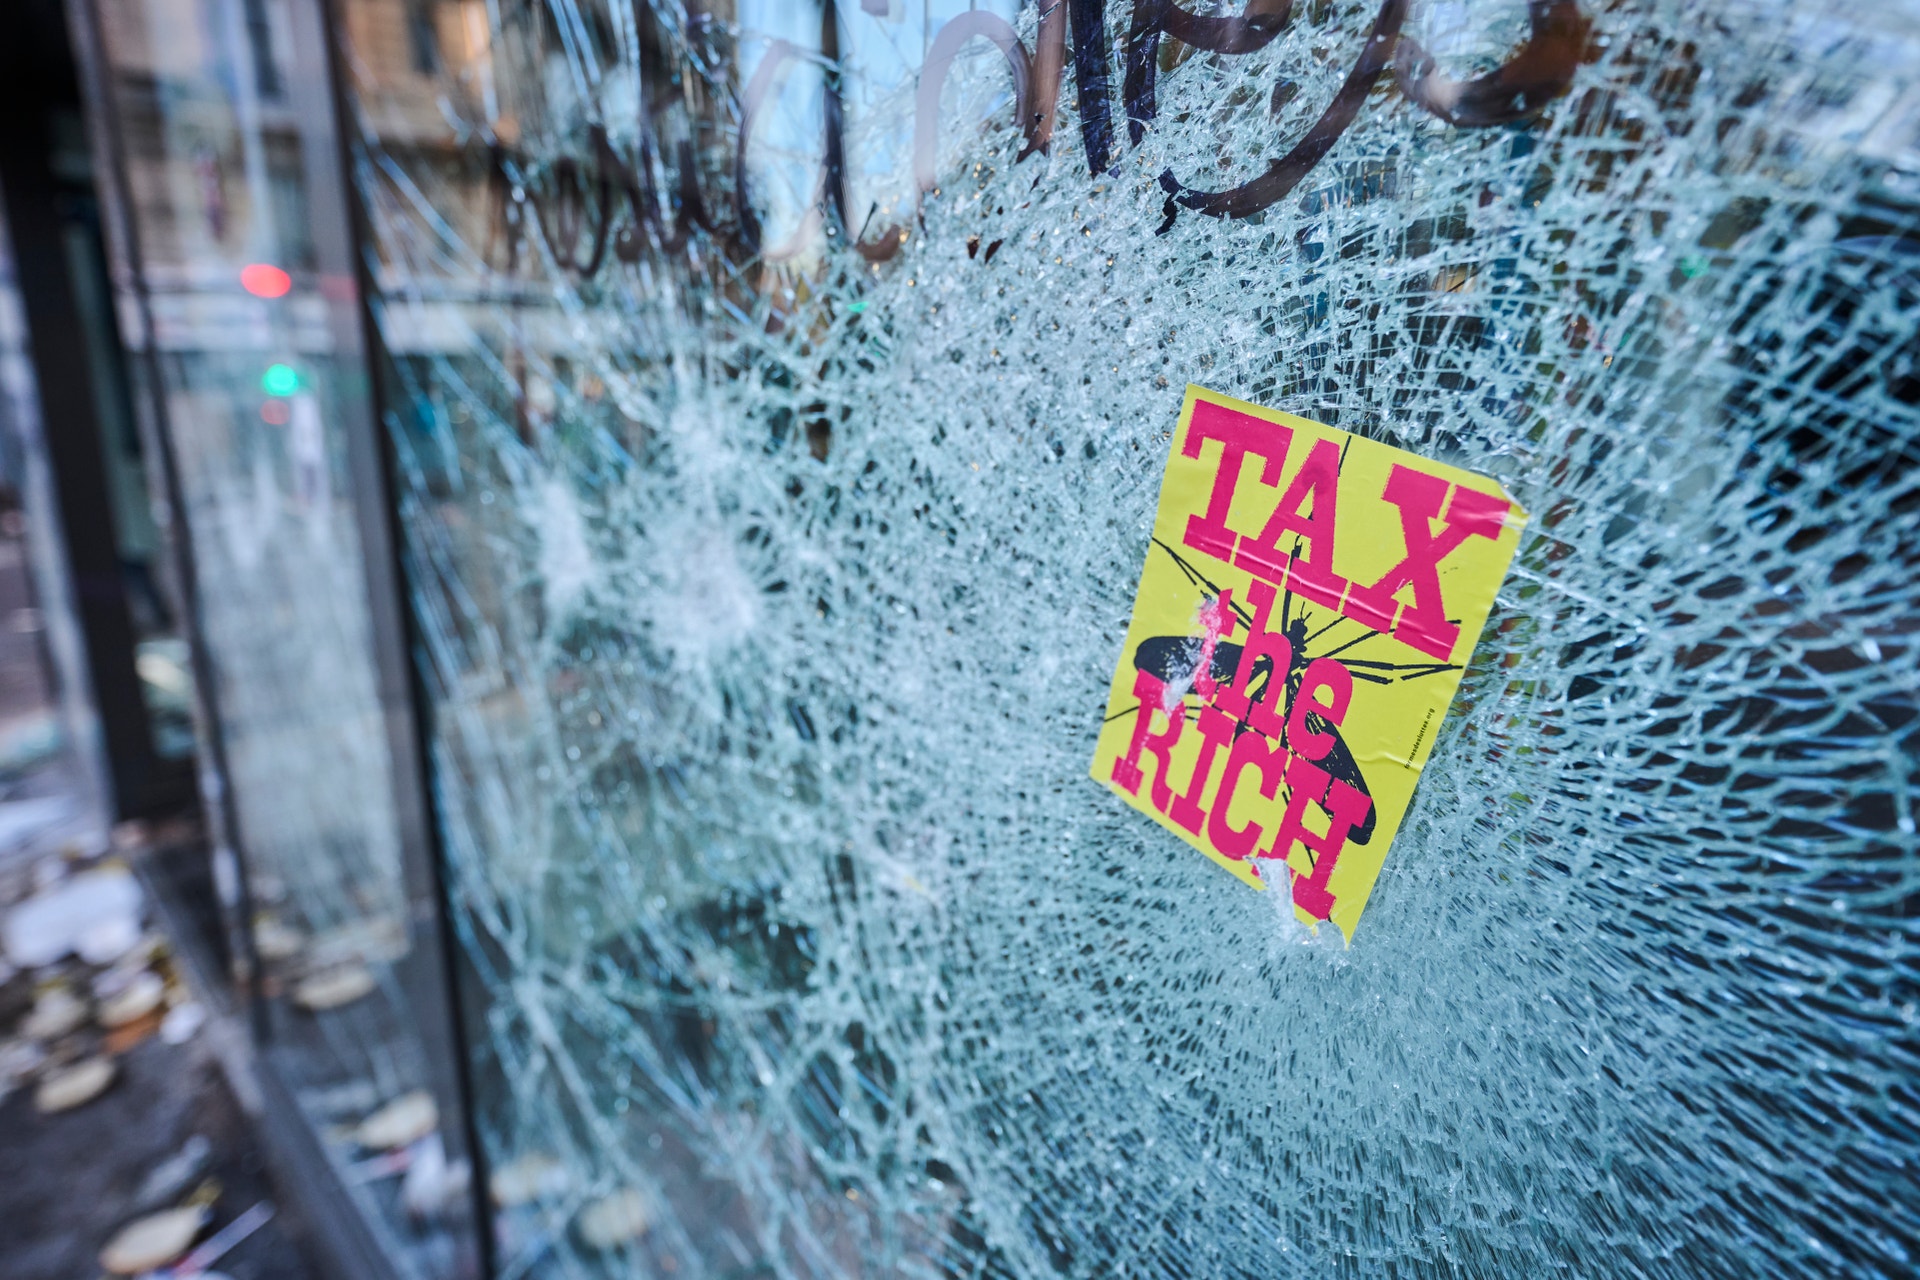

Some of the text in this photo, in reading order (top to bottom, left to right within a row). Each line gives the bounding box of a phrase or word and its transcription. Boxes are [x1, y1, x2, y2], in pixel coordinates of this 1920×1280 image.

[1182, 399, 1511, 662] TAX
[1194, 577, 1353, 761] the
[1404, 708, 1436, 769] formesdesluttes.org
[1111, 668, 1373, 920] RICH
